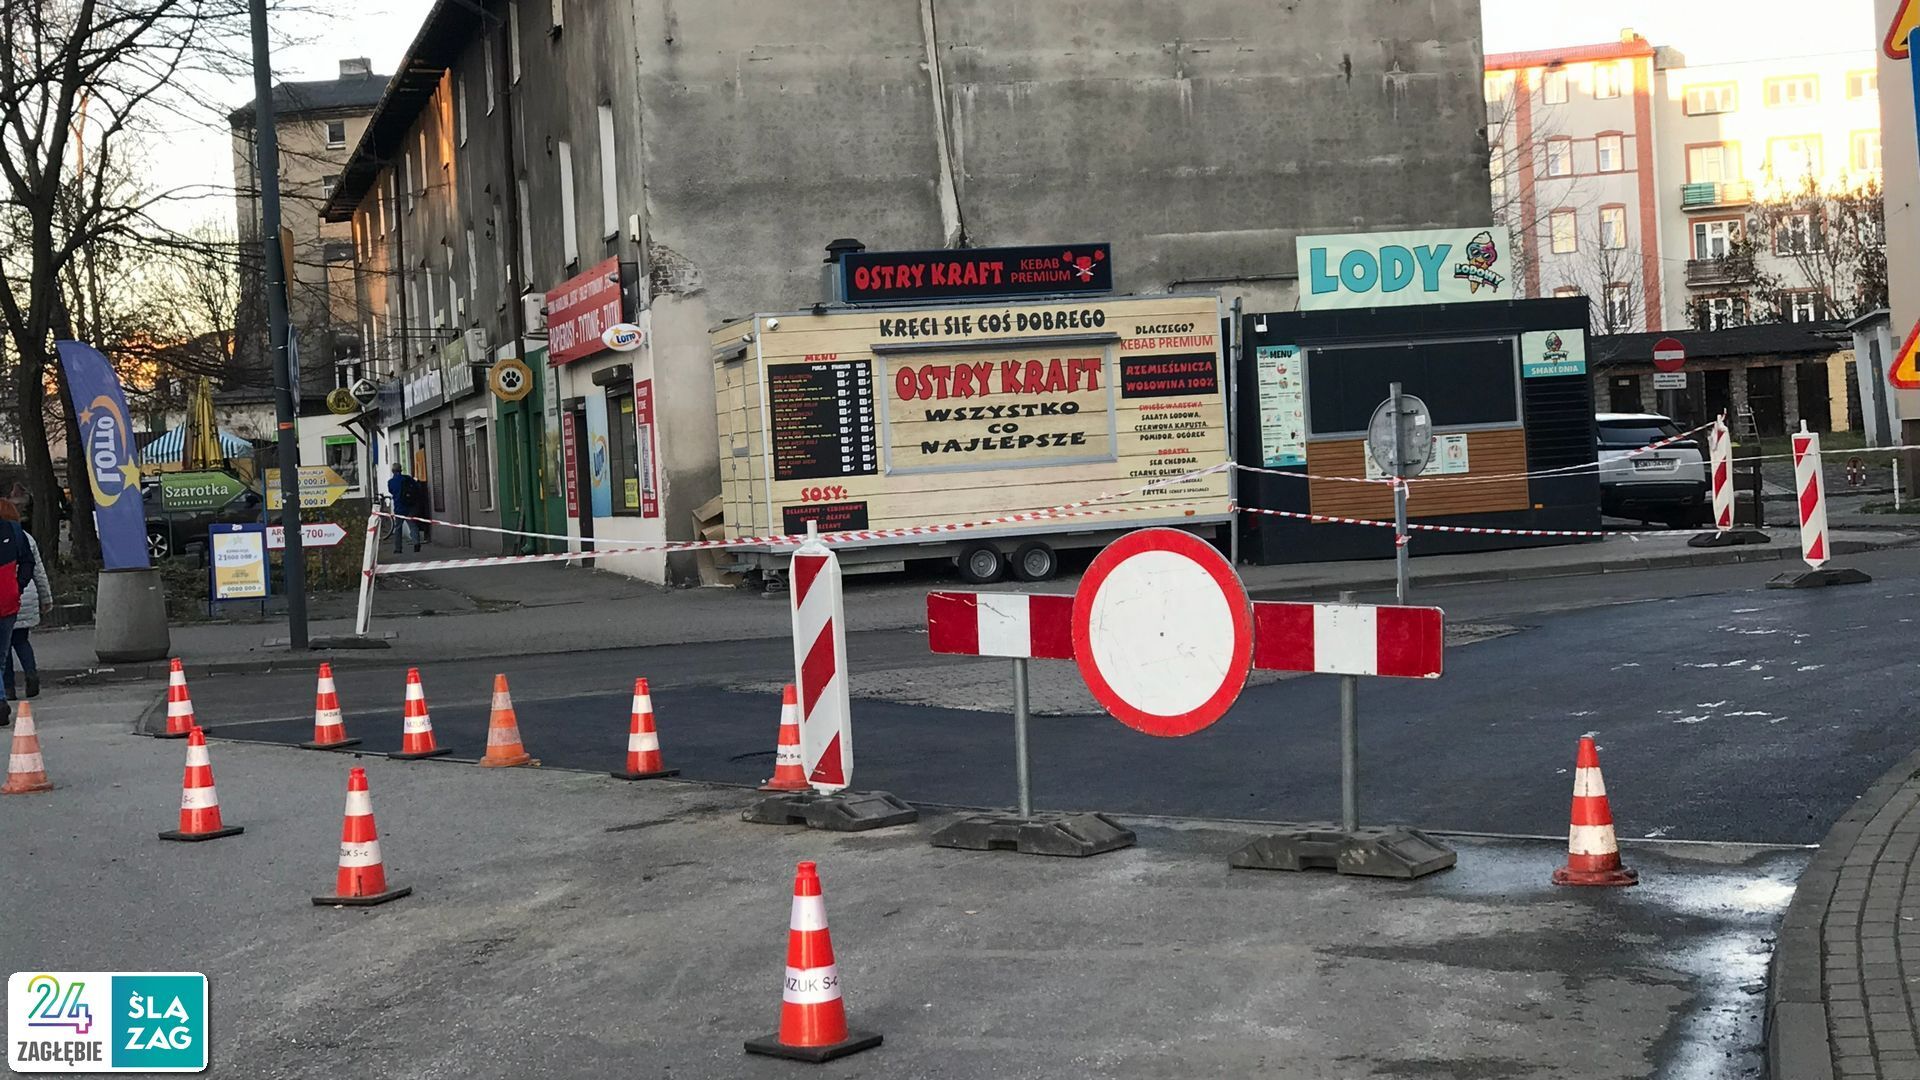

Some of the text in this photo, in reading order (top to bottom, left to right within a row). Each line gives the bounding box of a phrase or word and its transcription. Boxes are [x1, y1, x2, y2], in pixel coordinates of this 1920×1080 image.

[1020, 258, 1060, 271] KEBAB
[1310, 244, 1452, 294] LODY
[855, 261, 1004, 290] OSTRY KRAFT
[1010, 270, 1071, 283] PREMIUM
[1454, 263, 1505, 285] LODOWY
[879, 309, 1106, 340] KRĘCI SIĘ COŚ DOBREGO
[1135, 322, 1195, 335] DLACZEGO?
[616, 333, 636, 344] LOTTO
[1120, 335, 1214, 351] KEBAB PREMIUM
[804, 353, 838, 362] MENU
[1269, 350, 1293, 359] MENU
[1126, 359, 1213, 376] RZEMIEŚLNICZA
[1531, 365, 1579, 376] SMAKI DNIA
[895, 357, 1102, 401] OSTRY KRAFT
[1125, 377, 1215, 392] WOŁOWINA 100%
[924, 401, 1080, 422] WSZYSTKO
[987, 422, 1019, 434] CO
[921, 431, 1087, 455] NAJLEPSZE
[165, 483, 229, 499] Szarotka
[800, 485, 848, 502] SOSY:
